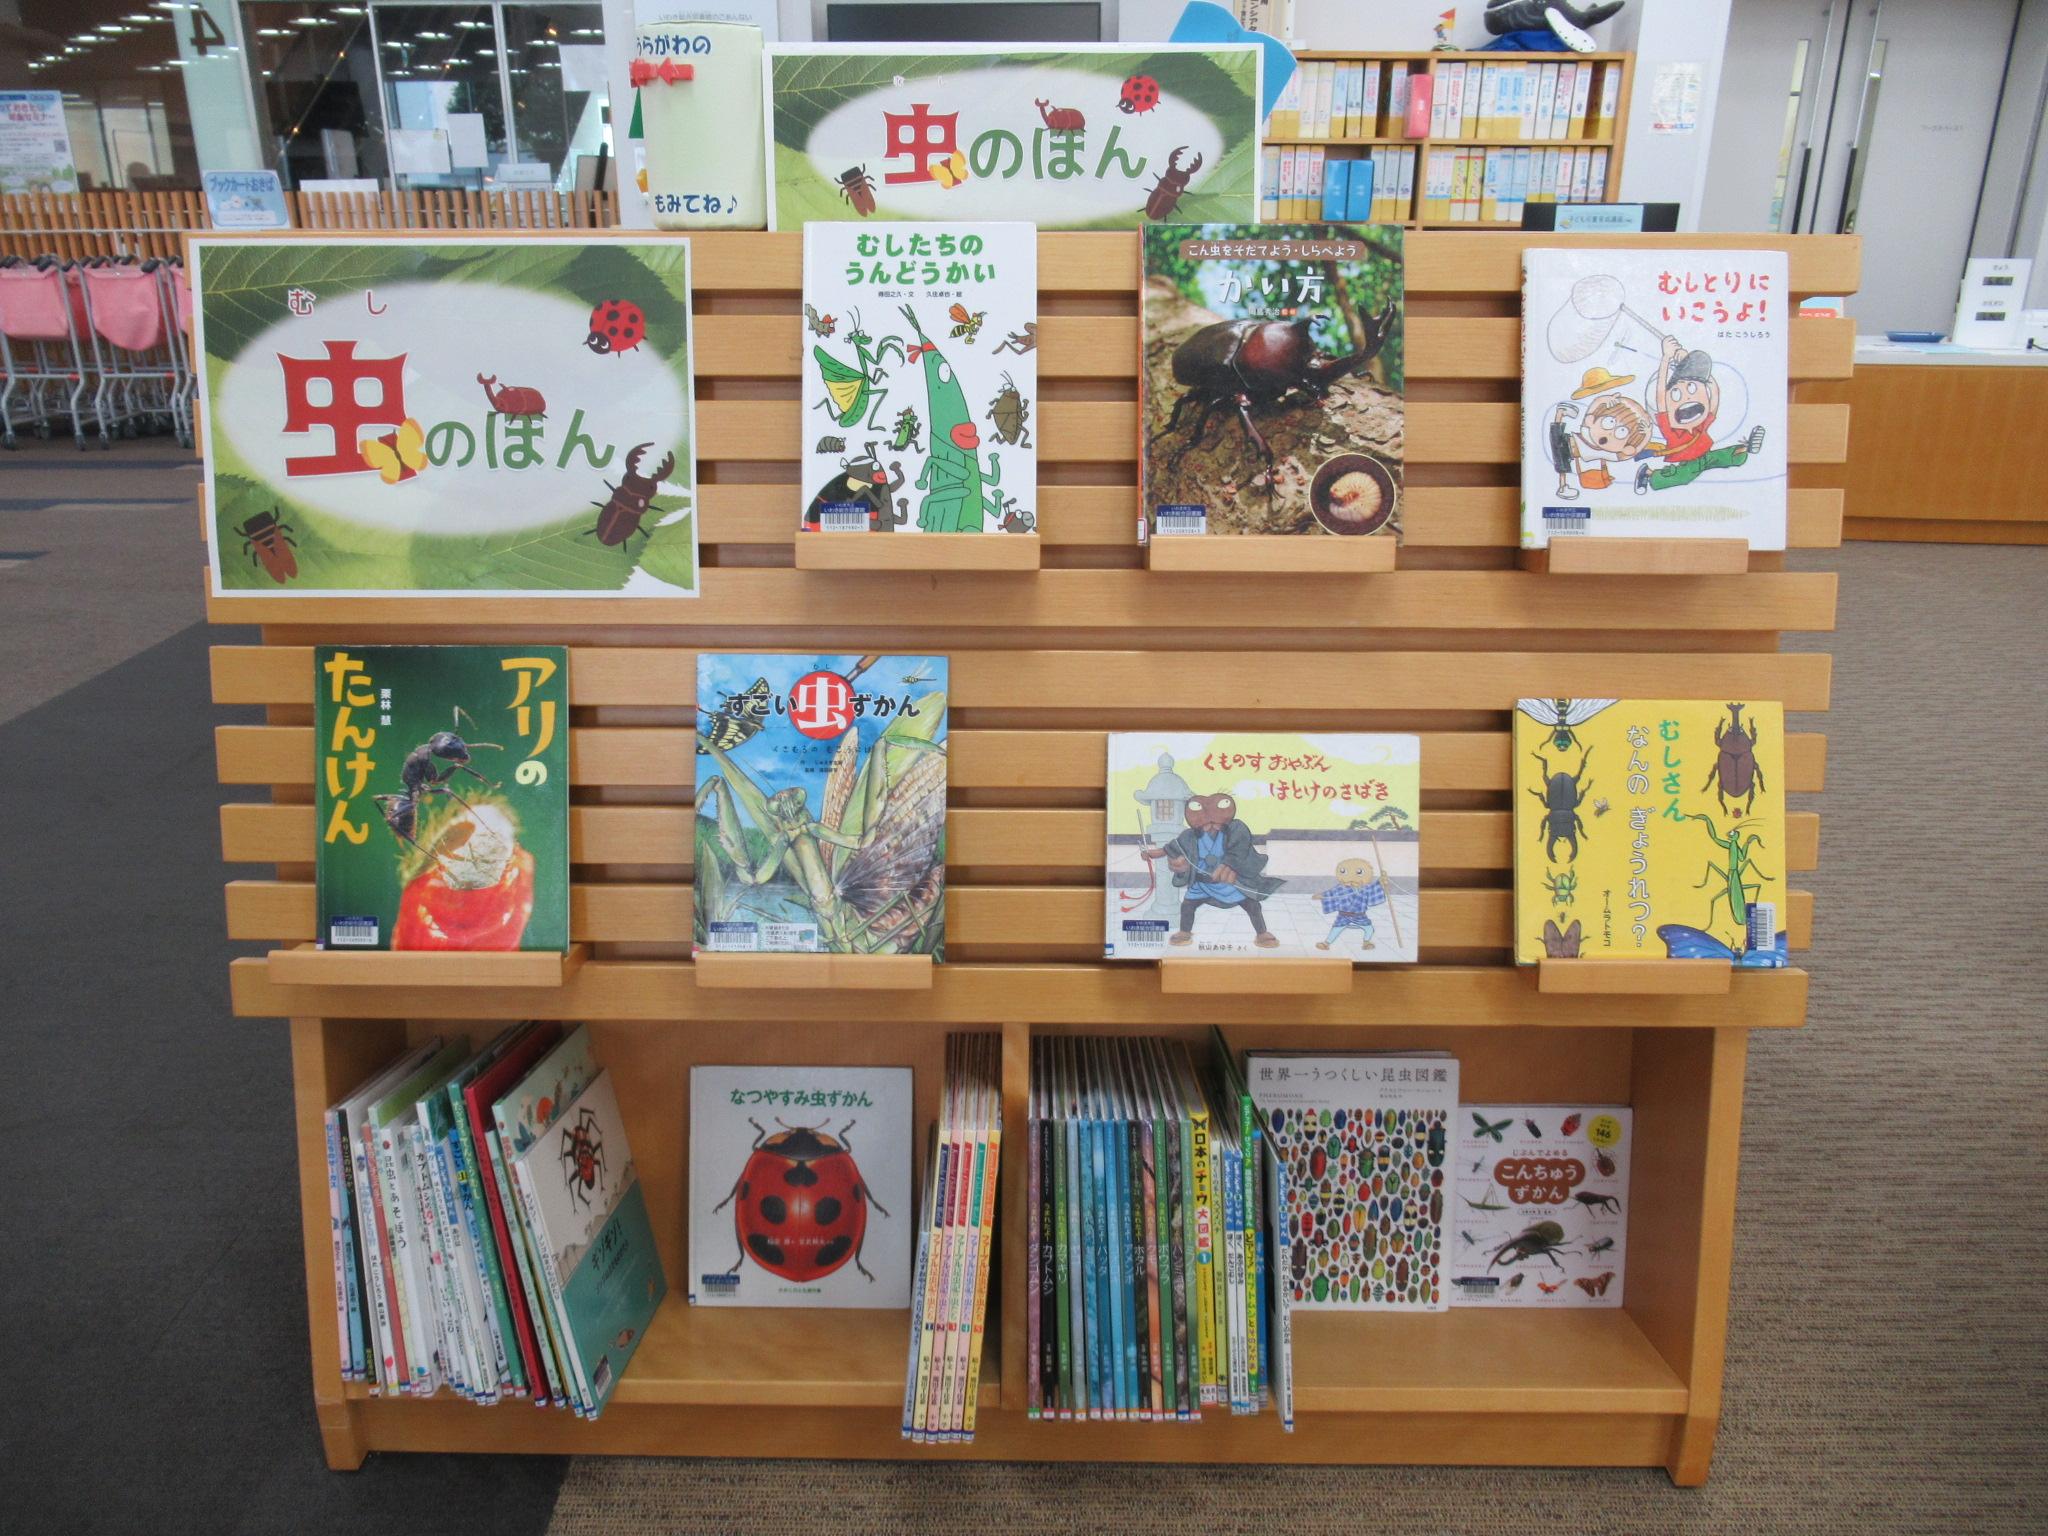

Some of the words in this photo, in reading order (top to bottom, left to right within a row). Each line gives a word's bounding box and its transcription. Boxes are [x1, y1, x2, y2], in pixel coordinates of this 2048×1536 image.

[882, 102, 1147, 190] 虫のほん
[856, 233, 984, 257] むしたちの
[1188, 244, 1357, 257] こん虫をそだてよう・しらべよう
[845, 261, 996, 286] うんどうかい
[1216, 266, 1326, 304] かい方
[1657, 271, 1770, 294] むしとりに
[1662, 299, 1767, 324] いこうよ！
[276, 339, 616, 481] 虫のほん
[727, 676, 921, 731] すごい虫ずかん
[500, 656, 557, 787] アリの
[323, 652, 377, 844] たんけん
[1626, 725, 1649, 795] なんの
[1658, 719, 1686, 823] むしさん
[1268, 779, 1391, 801] ほとけのさばき
[1627, 806, 1656, 948] ぎょうれつ？
[1259, 1066, 1448, 1083] 世界一うつくしい昆虫図鑑
[730, 1086, 874, 1108] なつやすみ虫ずかん
[1194, 1133, 1209, 1205] 日本のチョウ
[1501, 1164, 1579, 1180] こんちゅう
[1514, 1185, 1564, 1200] ずかん
[1042, 1245, 1054, 1296] カブトムシ
[1134, 1245, 1145, 1276] ホタル
